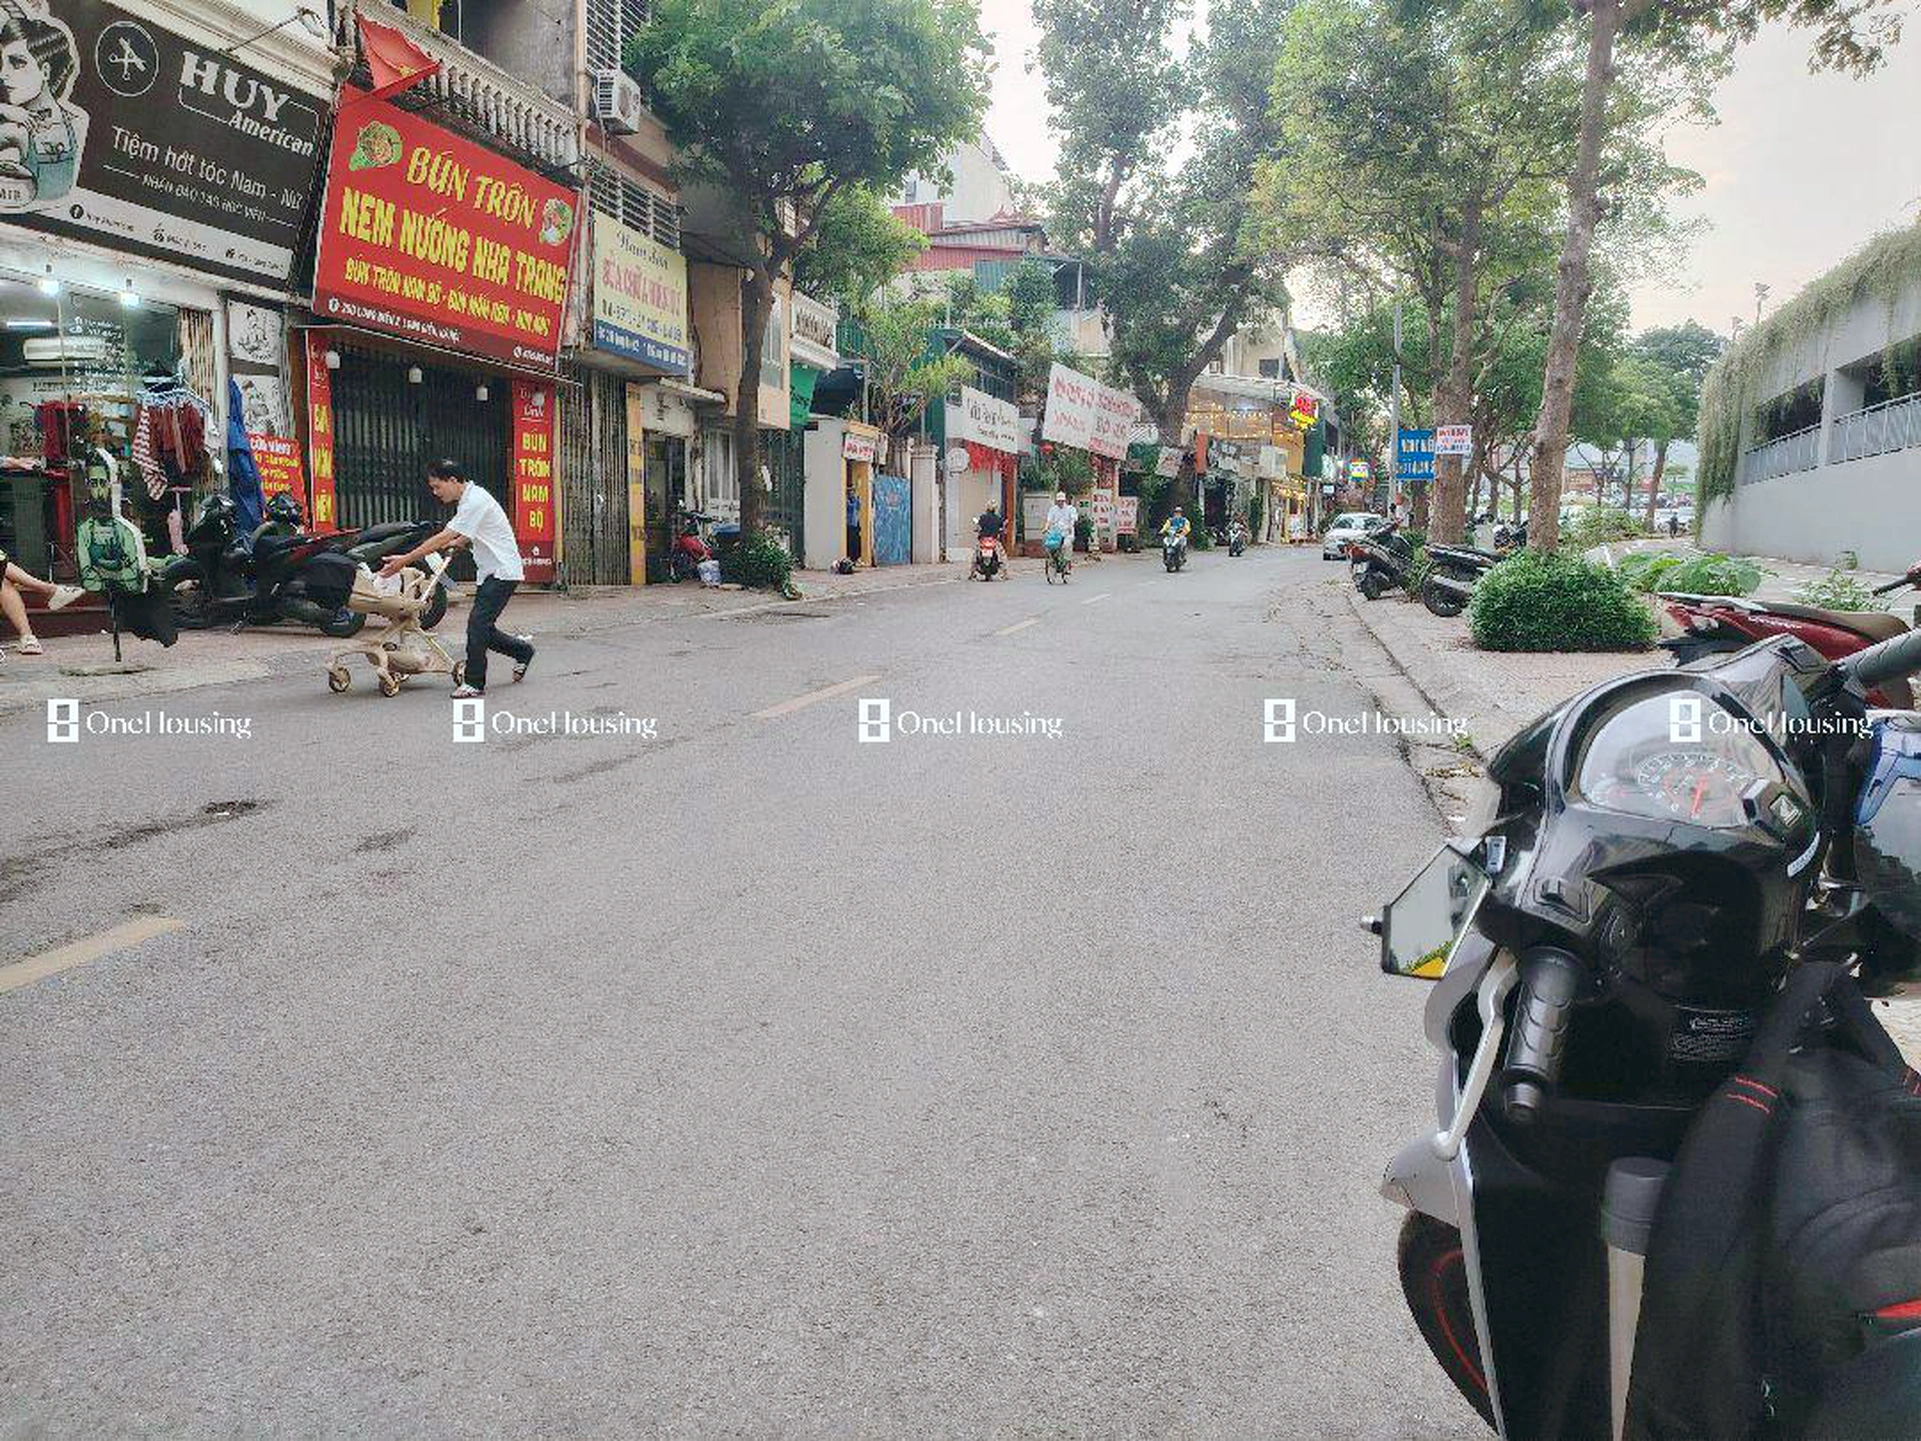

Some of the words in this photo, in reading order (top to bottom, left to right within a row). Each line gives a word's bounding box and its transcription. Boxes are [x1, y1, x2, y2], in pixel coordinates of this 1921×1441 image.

[180, 51, 290, 121] HUY
[111, 125, 159, 163] Tiệm
[199, 158, 227, 185] tóc
[230, 170, 266, 199] Nam
[228, 110, 314, 157] American
[407, 147, 470, 201] BÚN
[473, 175, 538, 229] TRỘN
[339, 187, 396, 248] NEM
[399, 207, 470, 273] NƯỚNG
[472, 236, 511, 286] NHA
[515, 250, 568, 304] TRANG
[522, 427, 547, 452] BÚN
[522, 484, 548, 503] NAM
[529, 506, 544, 533] BỘ
